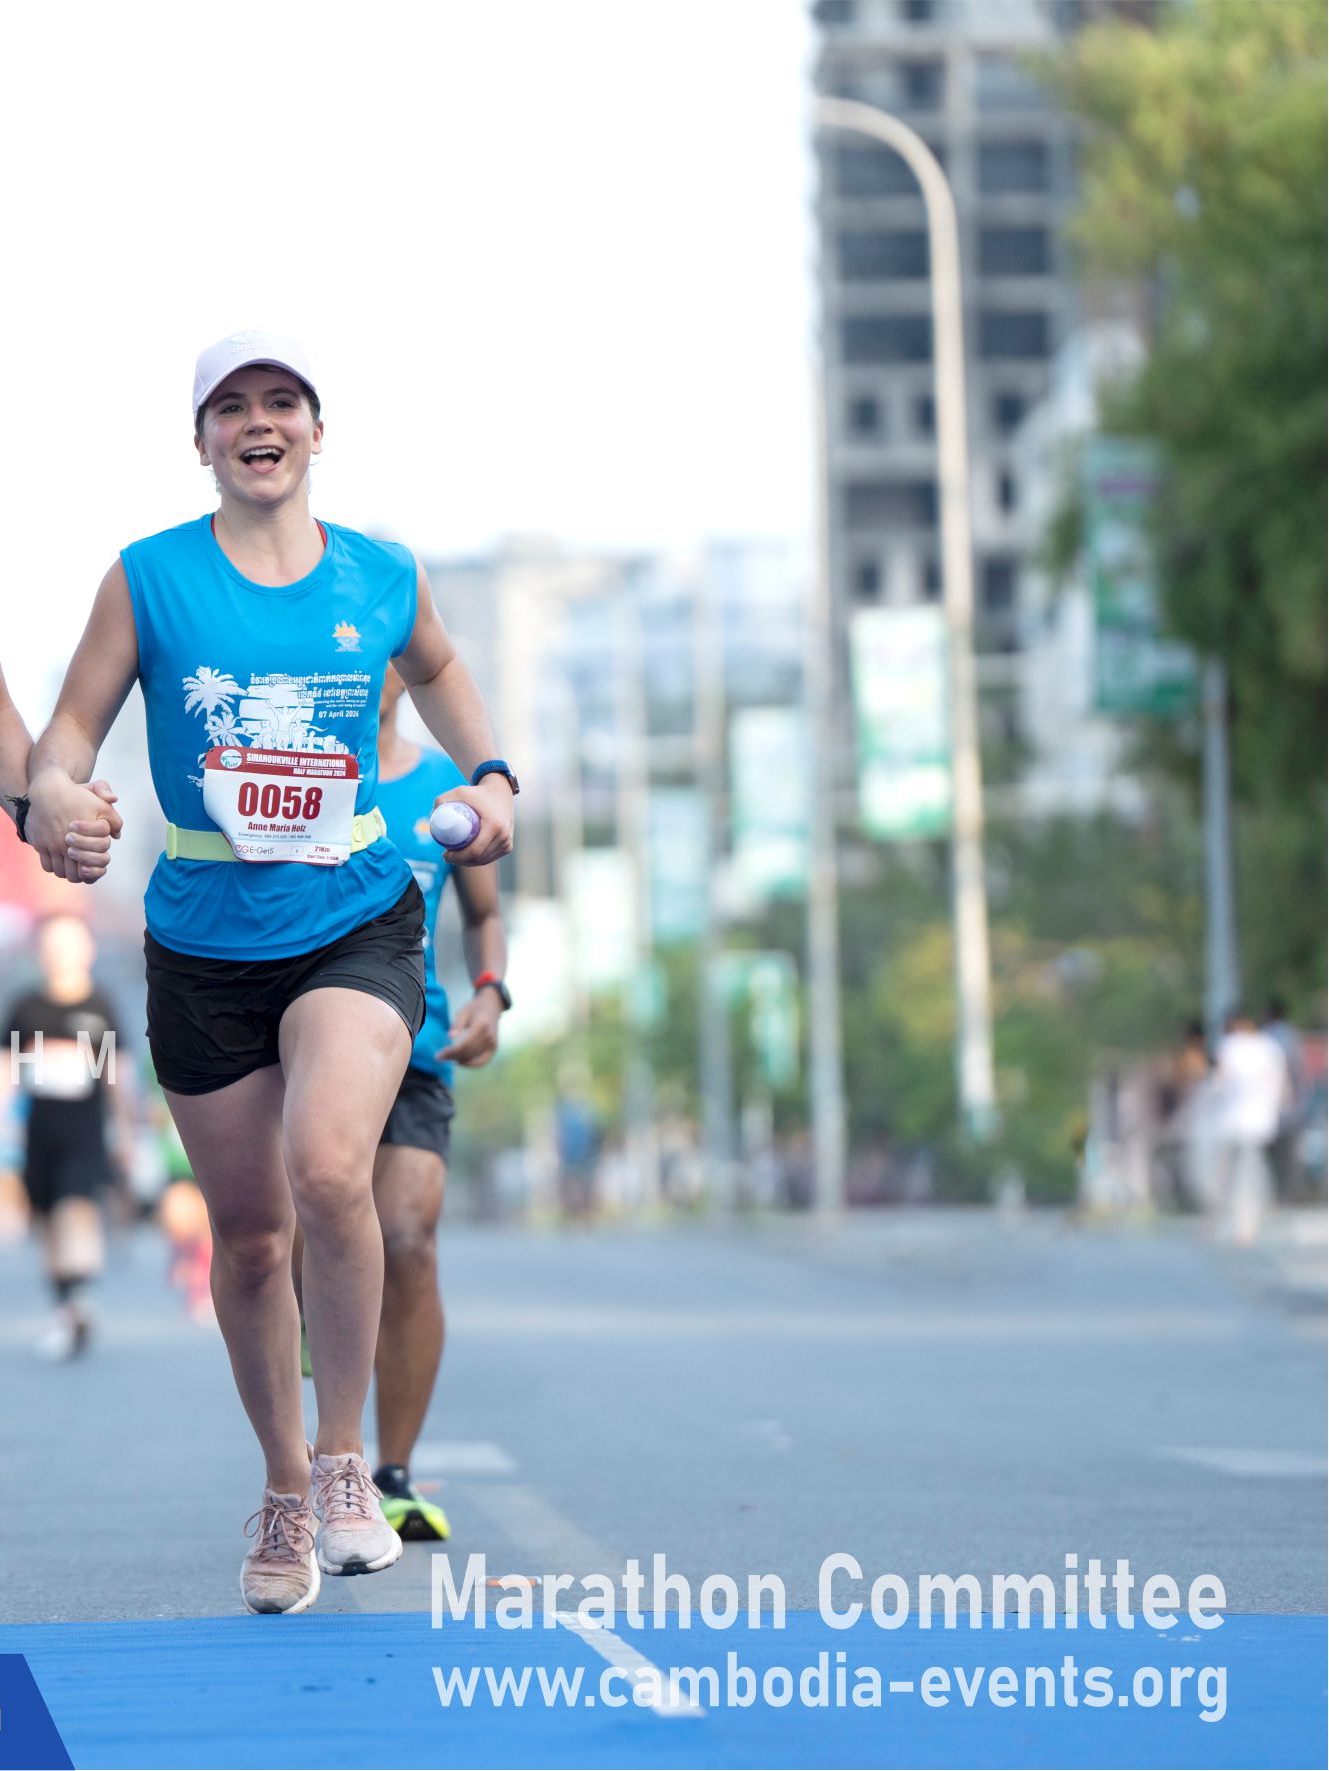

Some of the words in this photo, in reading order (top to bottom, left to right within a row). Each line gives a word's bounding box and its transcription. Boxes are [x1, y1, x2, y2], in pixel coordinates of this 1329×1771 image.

[329, 710, 344, 719] April
[346, 710, 359, 718] 2024
[246, 752, 299, 766] SIHANOUKVILLE
[299, 757, 346, 768] INTERNATIONAL
[237, 781, 324, 820] 0058
[247, 821, 268, 832] Anne
[269, 823, 290, 833] Maria
[291, 823, 307, 833] Holz
